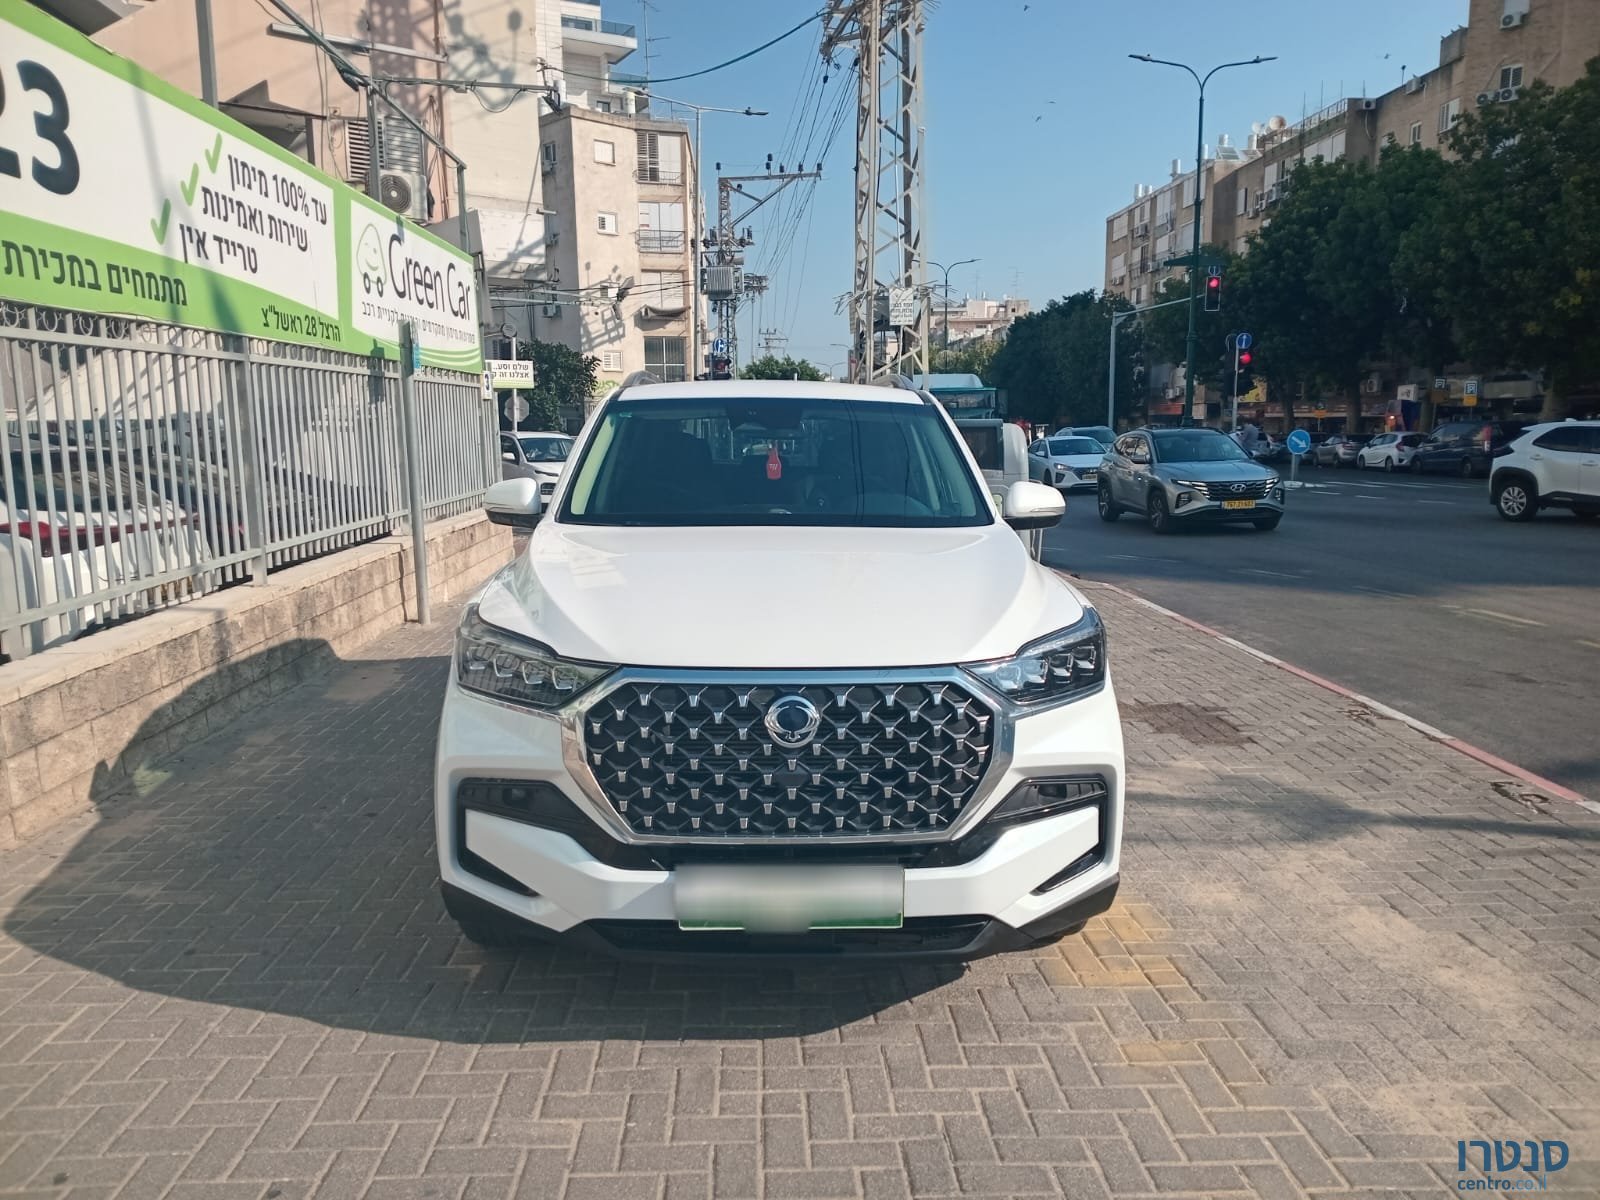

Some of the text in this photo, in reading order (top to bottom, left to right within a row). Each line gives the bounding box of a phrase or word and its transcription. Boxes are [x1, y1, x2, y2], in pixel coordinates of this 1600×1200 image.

[227, 154, 327, 225] עד 100% מימון
[201, 185, 308, 252] שירות ואמינות
[179, 223, 258, 274] טרייד אין
[1, 239, 188, 306] מתמחים במכירת
[388, 233, 471, 321] Green Car
[304, 314, 318, 337] 28
[362, 301, 376, 318] רכב
[318, 316, 341, 343] הרצל
[510, 370, 530, 378] אצלנו
[512, 362, 529, 370] שלם
